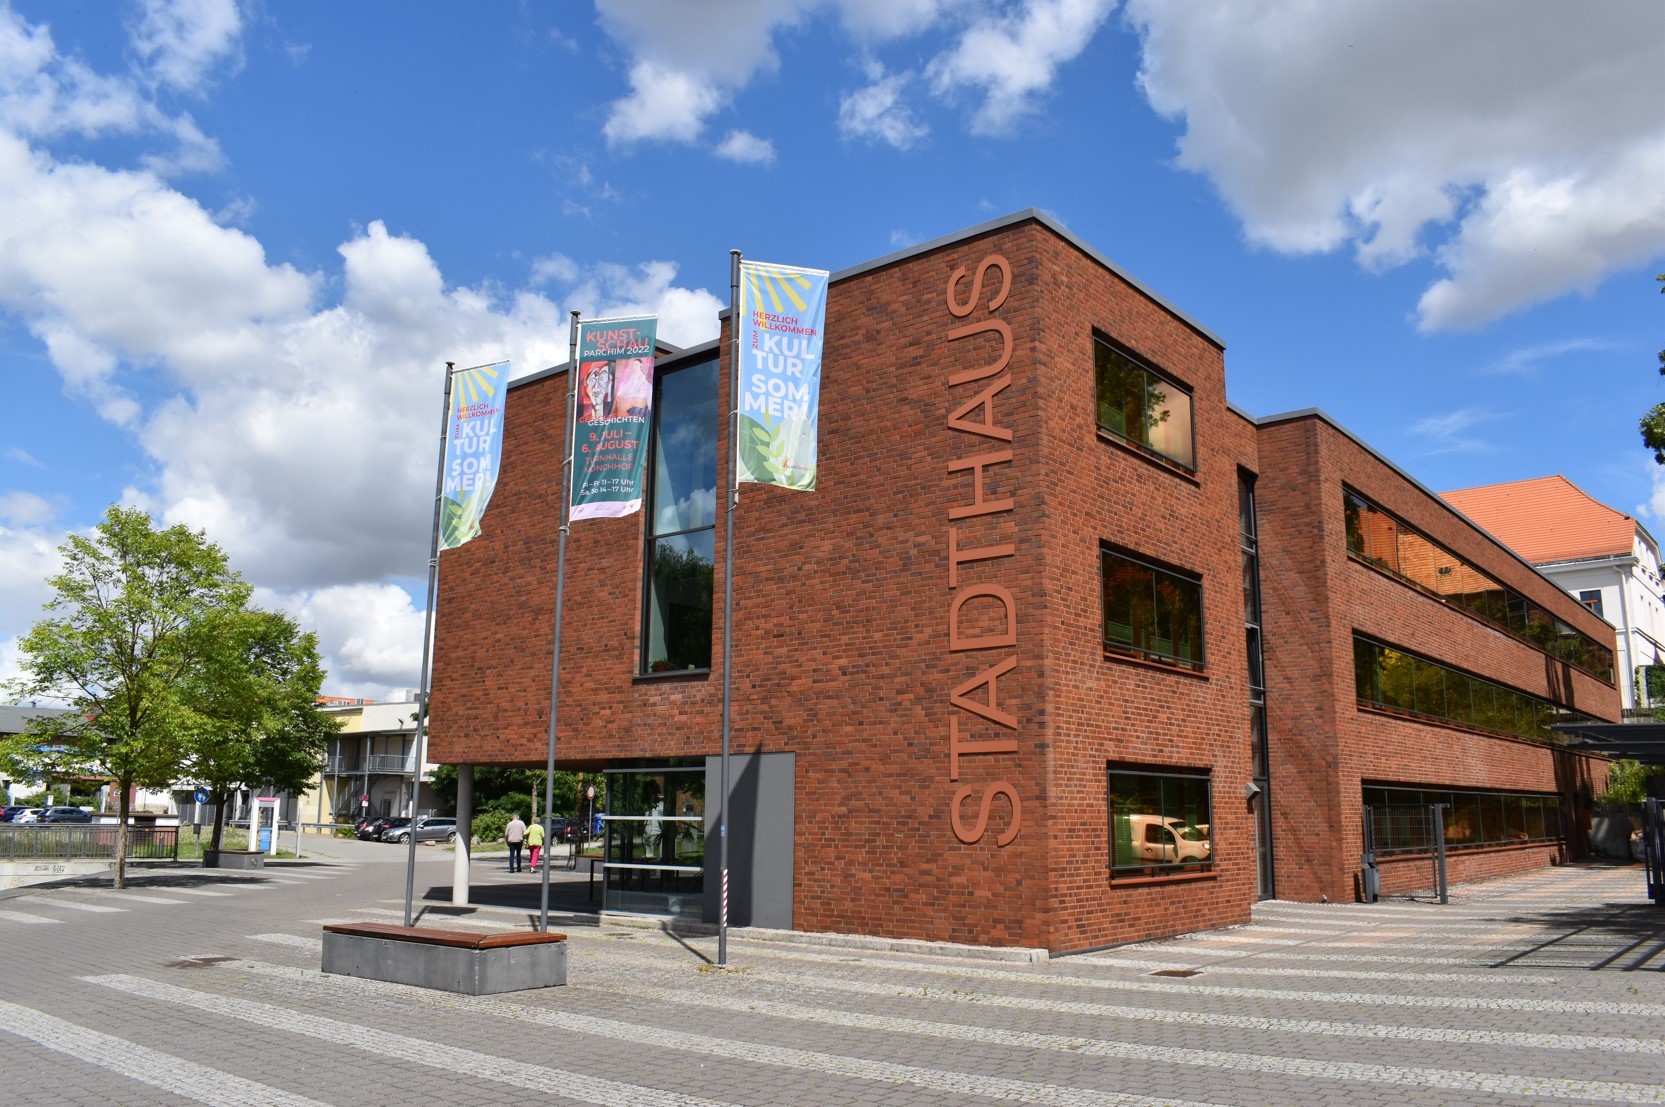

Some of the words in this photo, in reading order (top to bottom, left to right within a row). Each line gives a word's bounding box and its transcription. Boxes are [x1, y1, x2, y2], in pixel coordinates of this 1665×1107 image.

[753, 311, 798, 325] HERZLICH
[586, 328, 641, 342] KUNST-
[753, 319, 817, 336] WILLKOMMEN
[584, 348, 625, 357] PARCHIM
[626, 345, 650, 355] 2022
[597, 338, 649, 350] SCHAU
[764, 333, 815, 359] KUL
[752, 349, 803, 378] TUR
[751, 373, 809, 401] SOM
[457, 403, 489, 413] HERZLICH
[744, 391, 809, 421] MER!
[456, 408, 499, 420] WILLKOMMEN
[587, 415, 645, 427] GESCHICHTEN
[462, 418, 497, 438] KUL
[589, 432, 599, 441] 9.
[601, 429, 624, 441] JULI
[454, 435, 490, 455] TUR
[581, 444, 591, 453] 6.
[594, 440, 639, 452] AUGUST
[452, 454, 492, 476] SOM
[585, 453, 633, 465] TURNHALLE
[446, 470, 491, 493] MER!
[947, 254, 1021, 847] STADTHAUS
